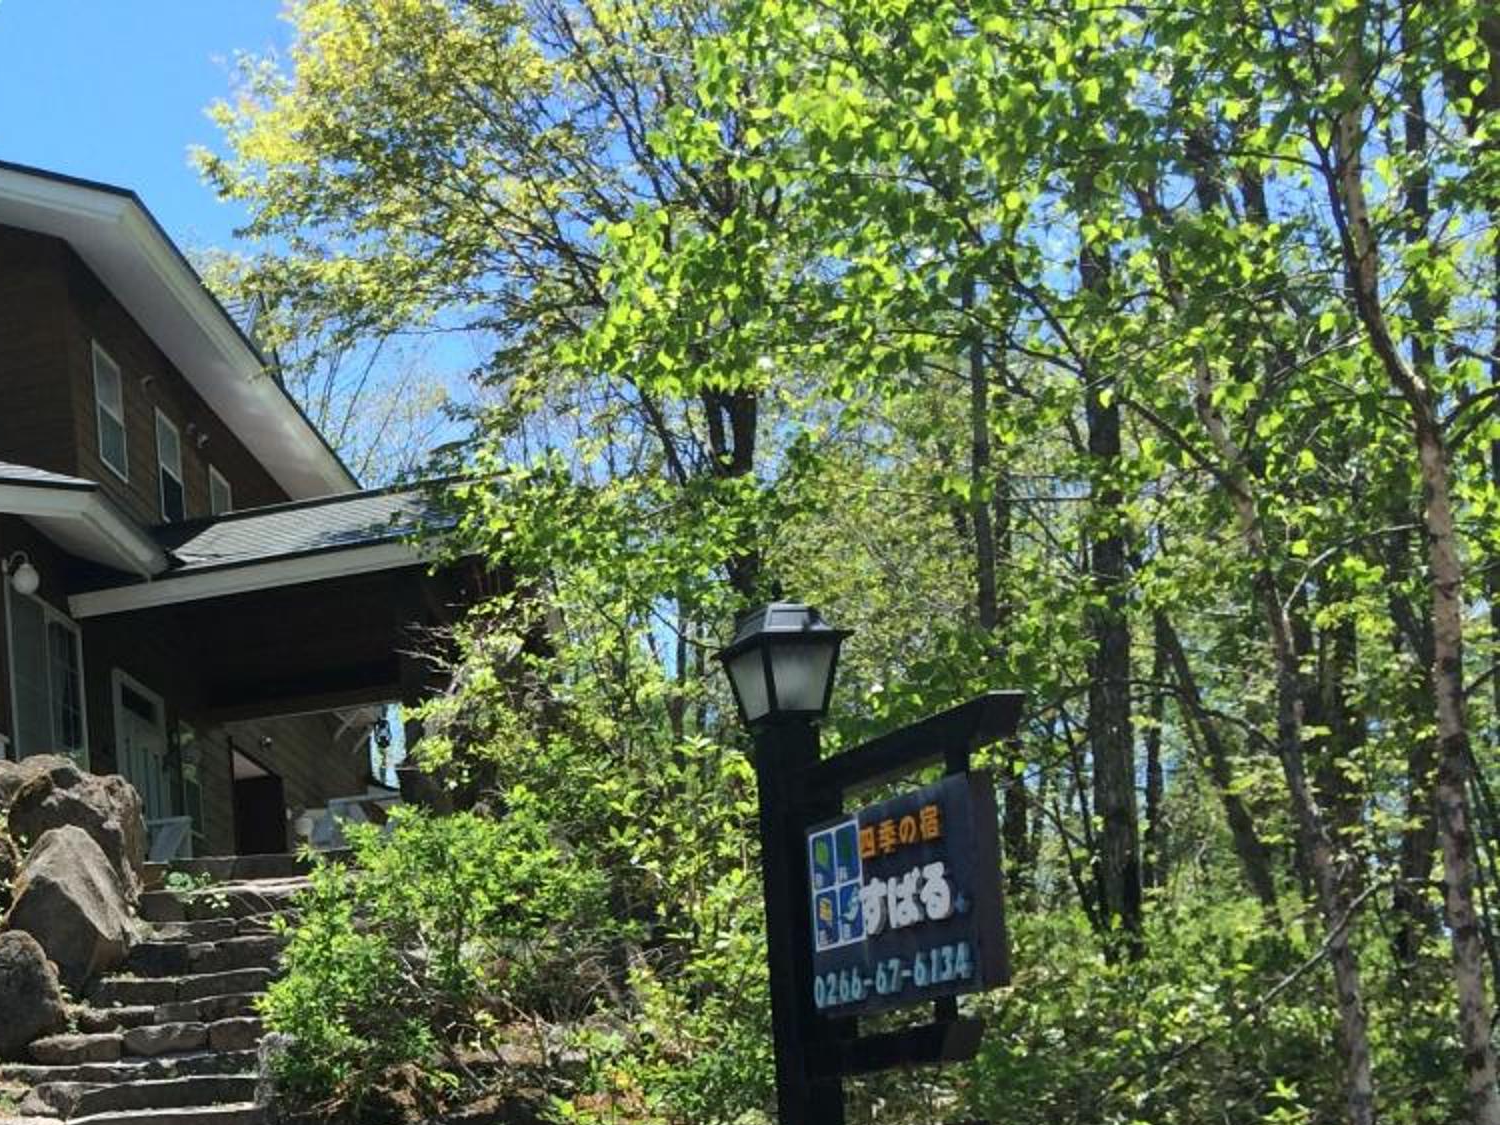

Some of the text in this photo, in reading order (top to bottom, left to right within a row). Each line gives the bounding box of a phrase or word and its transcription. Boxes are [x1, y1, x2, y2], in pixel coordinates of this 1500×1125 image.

[859, 805, 940, 858] 四季の宿
[859, 862, 950, 935] すばる
[813, 942, 969, 1008] 0266-67-6134
